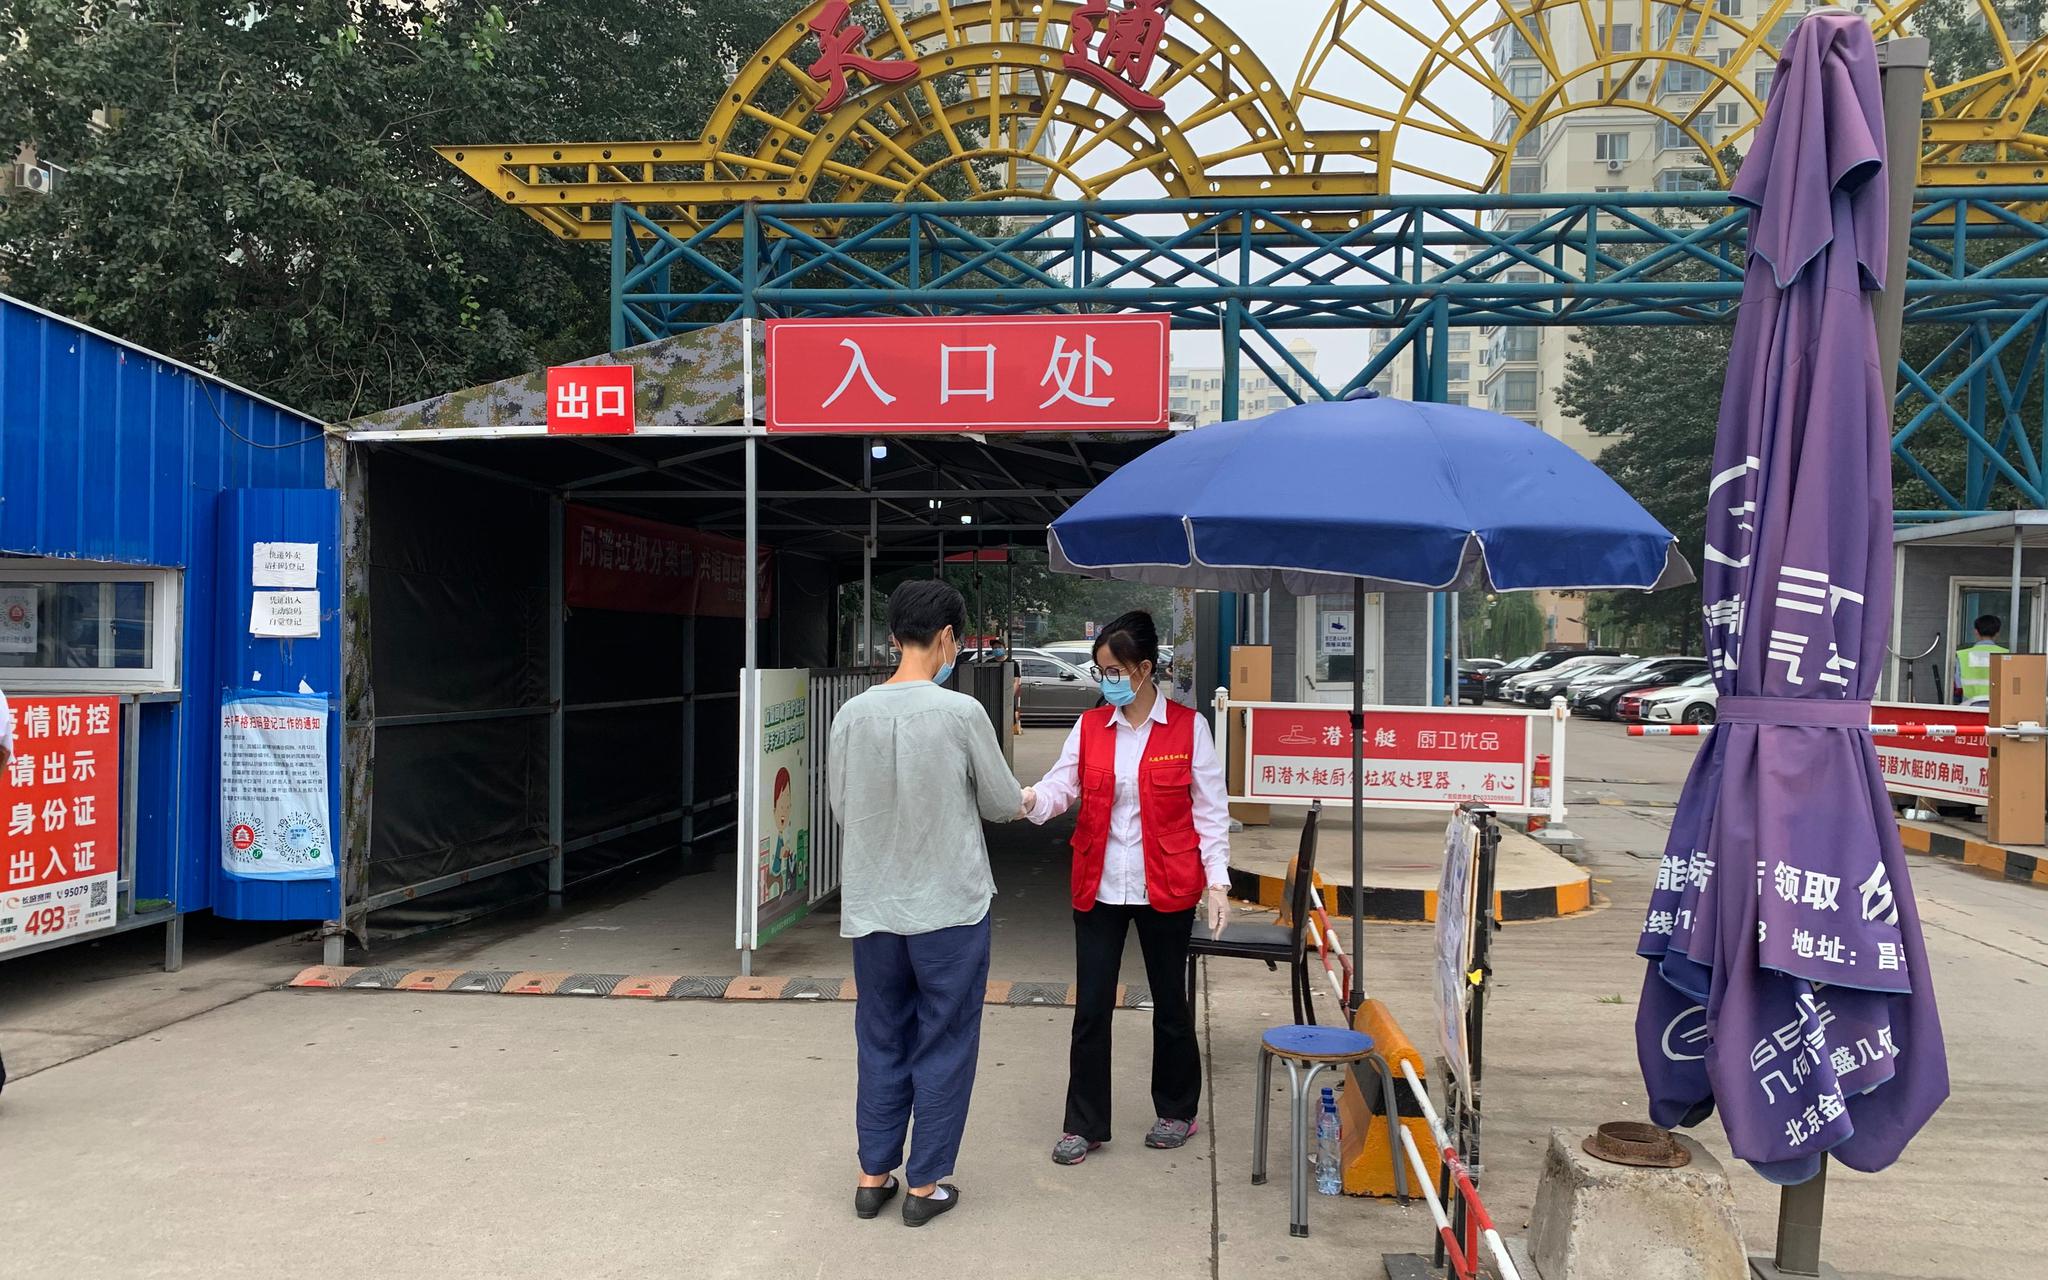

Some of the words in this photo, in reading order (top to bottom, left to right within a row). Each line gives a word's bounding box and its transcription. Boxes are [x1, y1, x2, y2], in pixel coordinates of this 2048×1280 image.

[821, 334, 1116, 410] 入口处
[556, 381, 627, 420] 出口
[1417, 730, 1500, 751] 厨卫优品
[8, 750, 96, 788] 请出示
[1481, 772, 1516, 792] 省心
[8, 795, 96, 837] 身份证
[8, 840, 96, 886] 出入证
[64, 884, 89, 898] 95079
[1774, 860, 1841, 912] 领取
[25, 905, 65, 936] 493
